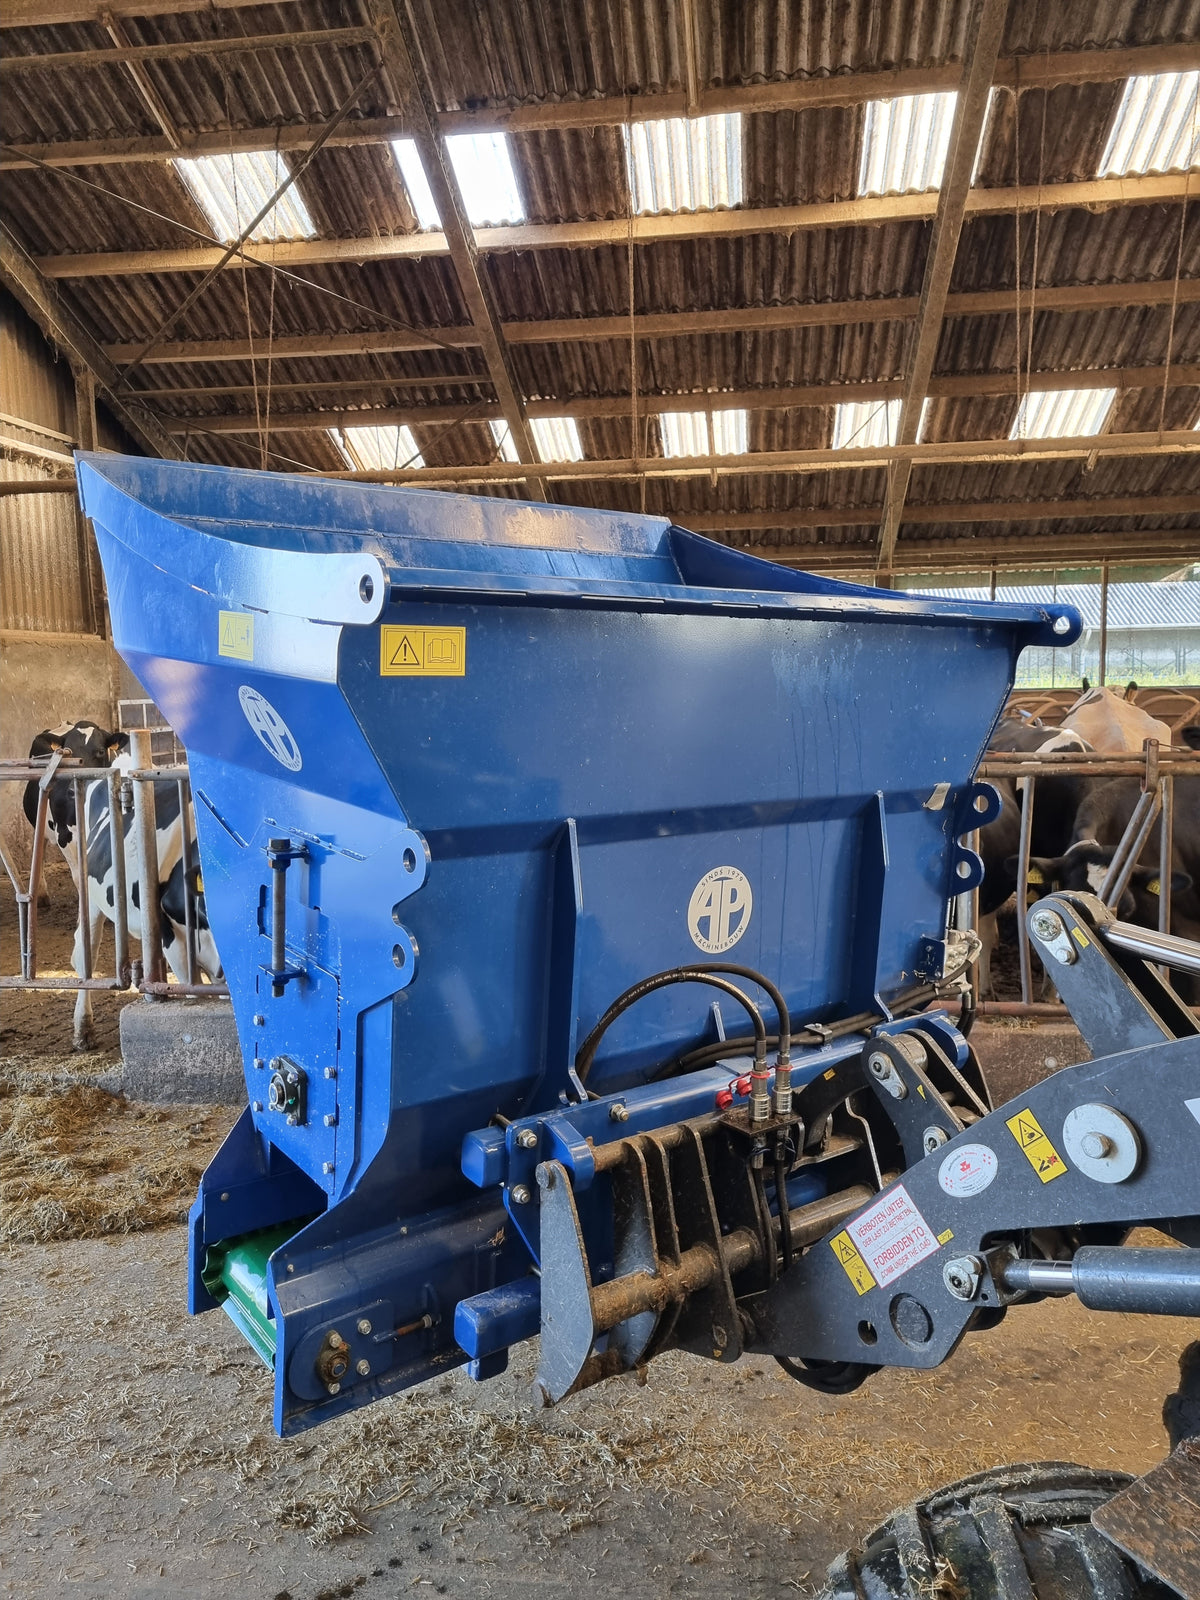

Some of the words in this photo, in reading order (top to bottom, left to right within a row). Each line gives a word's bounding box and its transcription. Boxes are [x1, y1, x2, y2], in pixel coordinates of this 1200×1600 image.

[701, 868, 724, 887] SINDS
[727, 869, 744, 882] 1979
[694, 925, 744, 950] MACHINEBOUW
[857, 1212, 887, 1237] VERBOTEN
[885, 1197, 905, 1216] UNTER
[863, 1237, 873, 1247] DER
[872, 1229, 882, 1241] LAST
[882, 1223, 890, 1233] ZU
[889, 1208, 912, 1227] BETRETEN
[874, 1236, 914, 1268] FORBIDDEN
[912, 1226, 925, 1241] TO
[894, 1255, 909, 1271] UNDER
[909, 1247, 918, 1259] THE
[918, 1240, 931, 1252] LOAD
